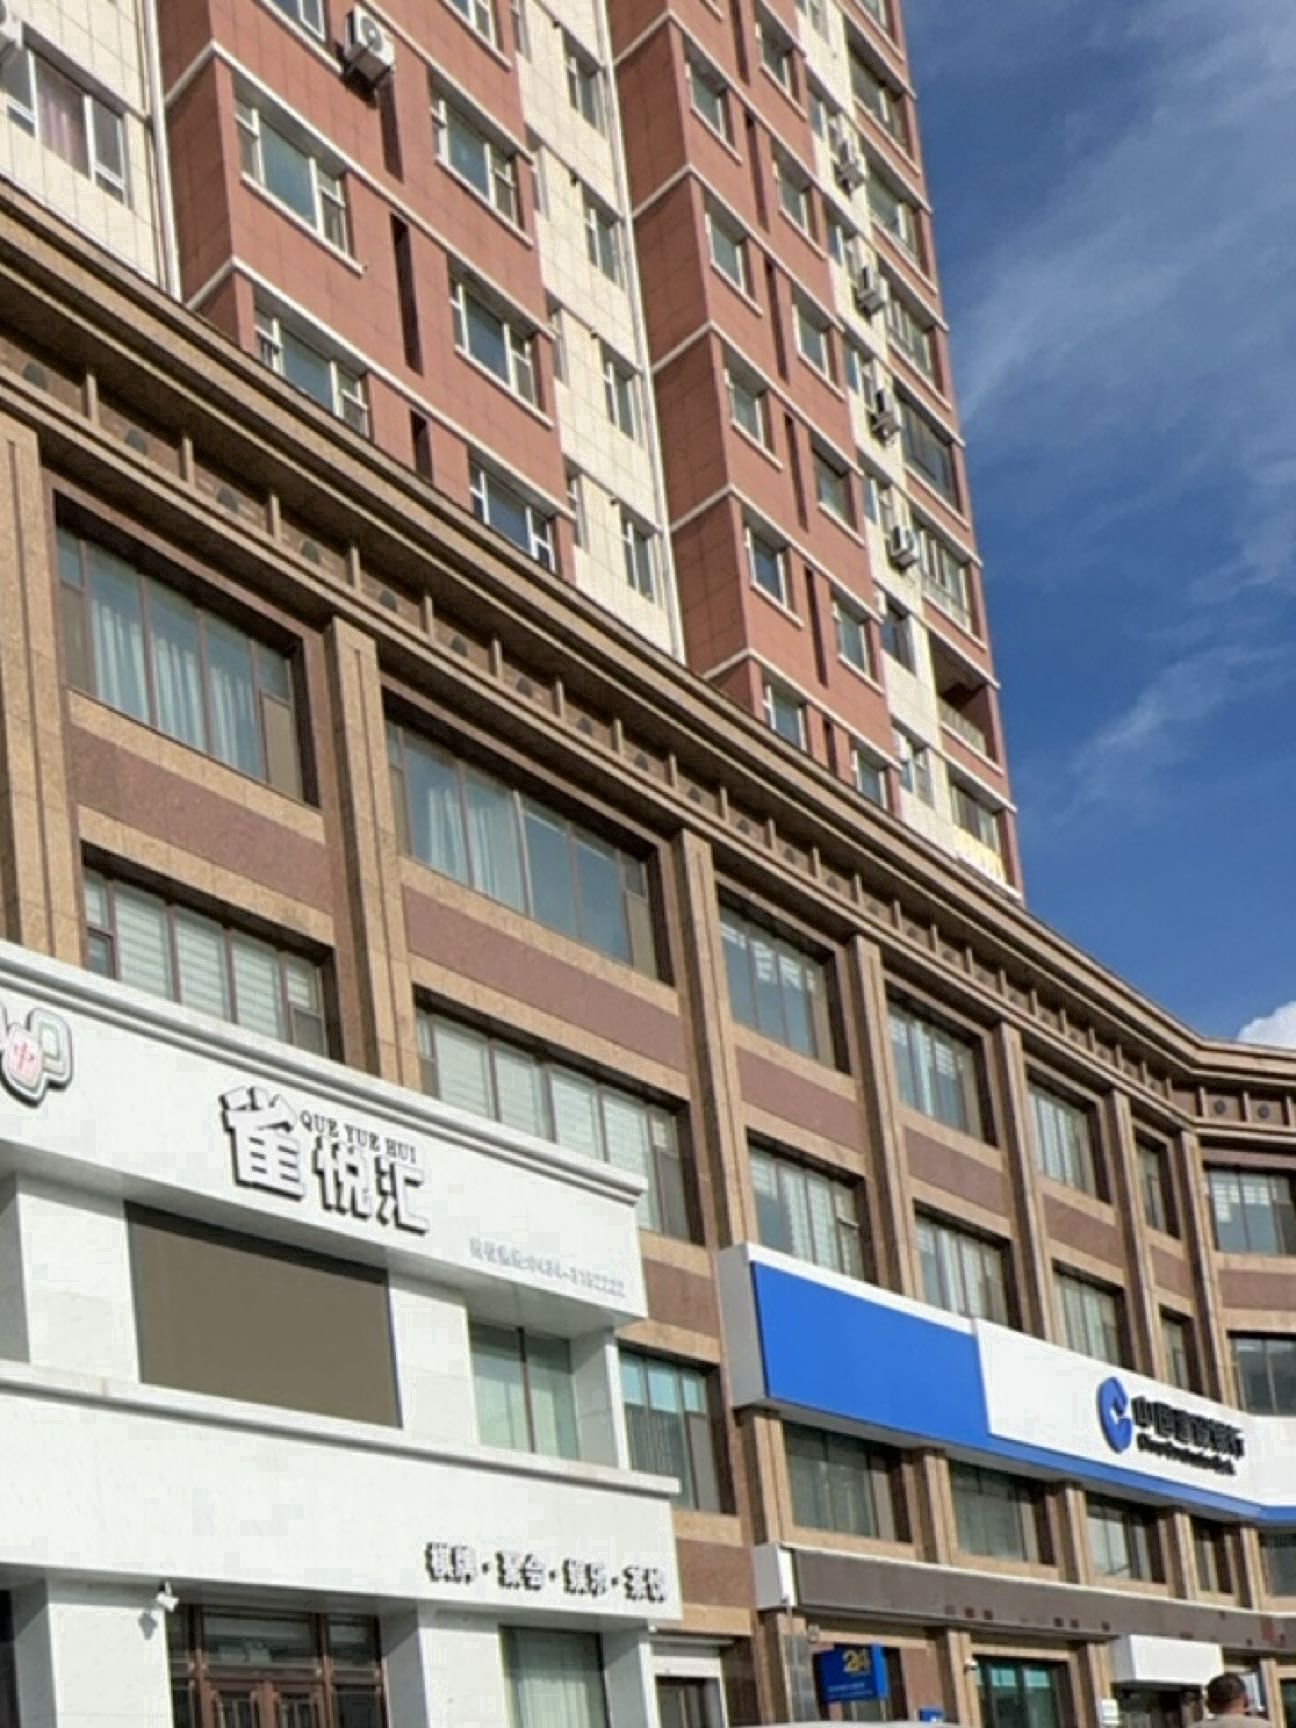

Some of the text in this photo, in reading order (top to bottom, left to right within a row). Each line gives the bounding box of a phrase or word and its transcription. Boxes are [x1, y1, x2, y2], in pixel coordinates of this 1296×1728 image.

[300, 1109, 416, 1164] QUE YUE HUI
